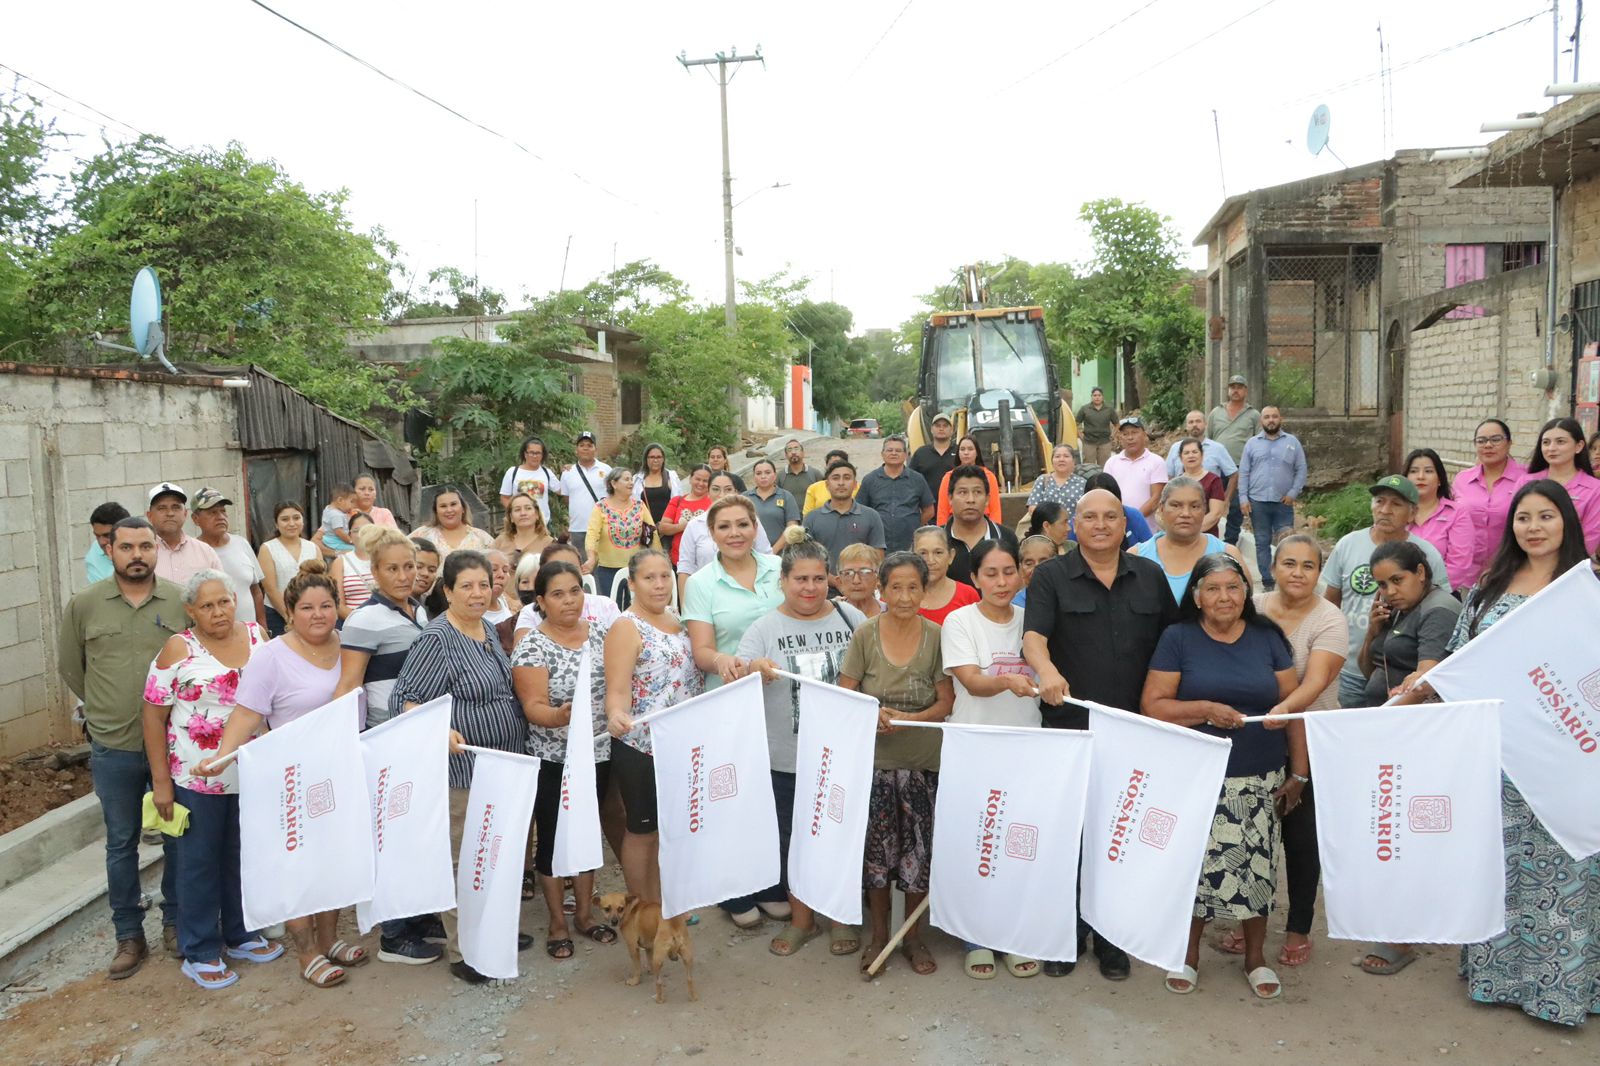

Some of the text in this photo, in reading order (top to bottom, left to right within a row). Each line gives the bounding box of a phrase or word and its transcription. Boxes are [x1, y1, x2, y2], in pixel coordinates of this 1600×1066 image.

[778, 631, 851, 650] NEW YORK
[783, 645, 830, 655] MANHATTAN
[1528, 666, 1597, 753] ROSARIO
[1536, 697, 1550, 714] 2024
[1543, 662, 1593, 726] GOBIERNO
[284, 765, 298, 852] ROSARIO
[377, 767, 388, 852] ROSARIO
[689, 746, 701, 833] ROSARIO
[811, 746, 829, 836] ROSARIO
[978, 789, 1002, 877] ROSARIO
[1108, 768, 1144, 862] ROSARIO
[1118, 773, 1150, 864] GOBIERNO DE
[1376, 764, 1394, 862] ROSARIO
[473, 804, 492, 891] ROSARIO
[991, 791, 1008, 879] GOBIERNO DE
[1394, 847, 1401, 861] DE
